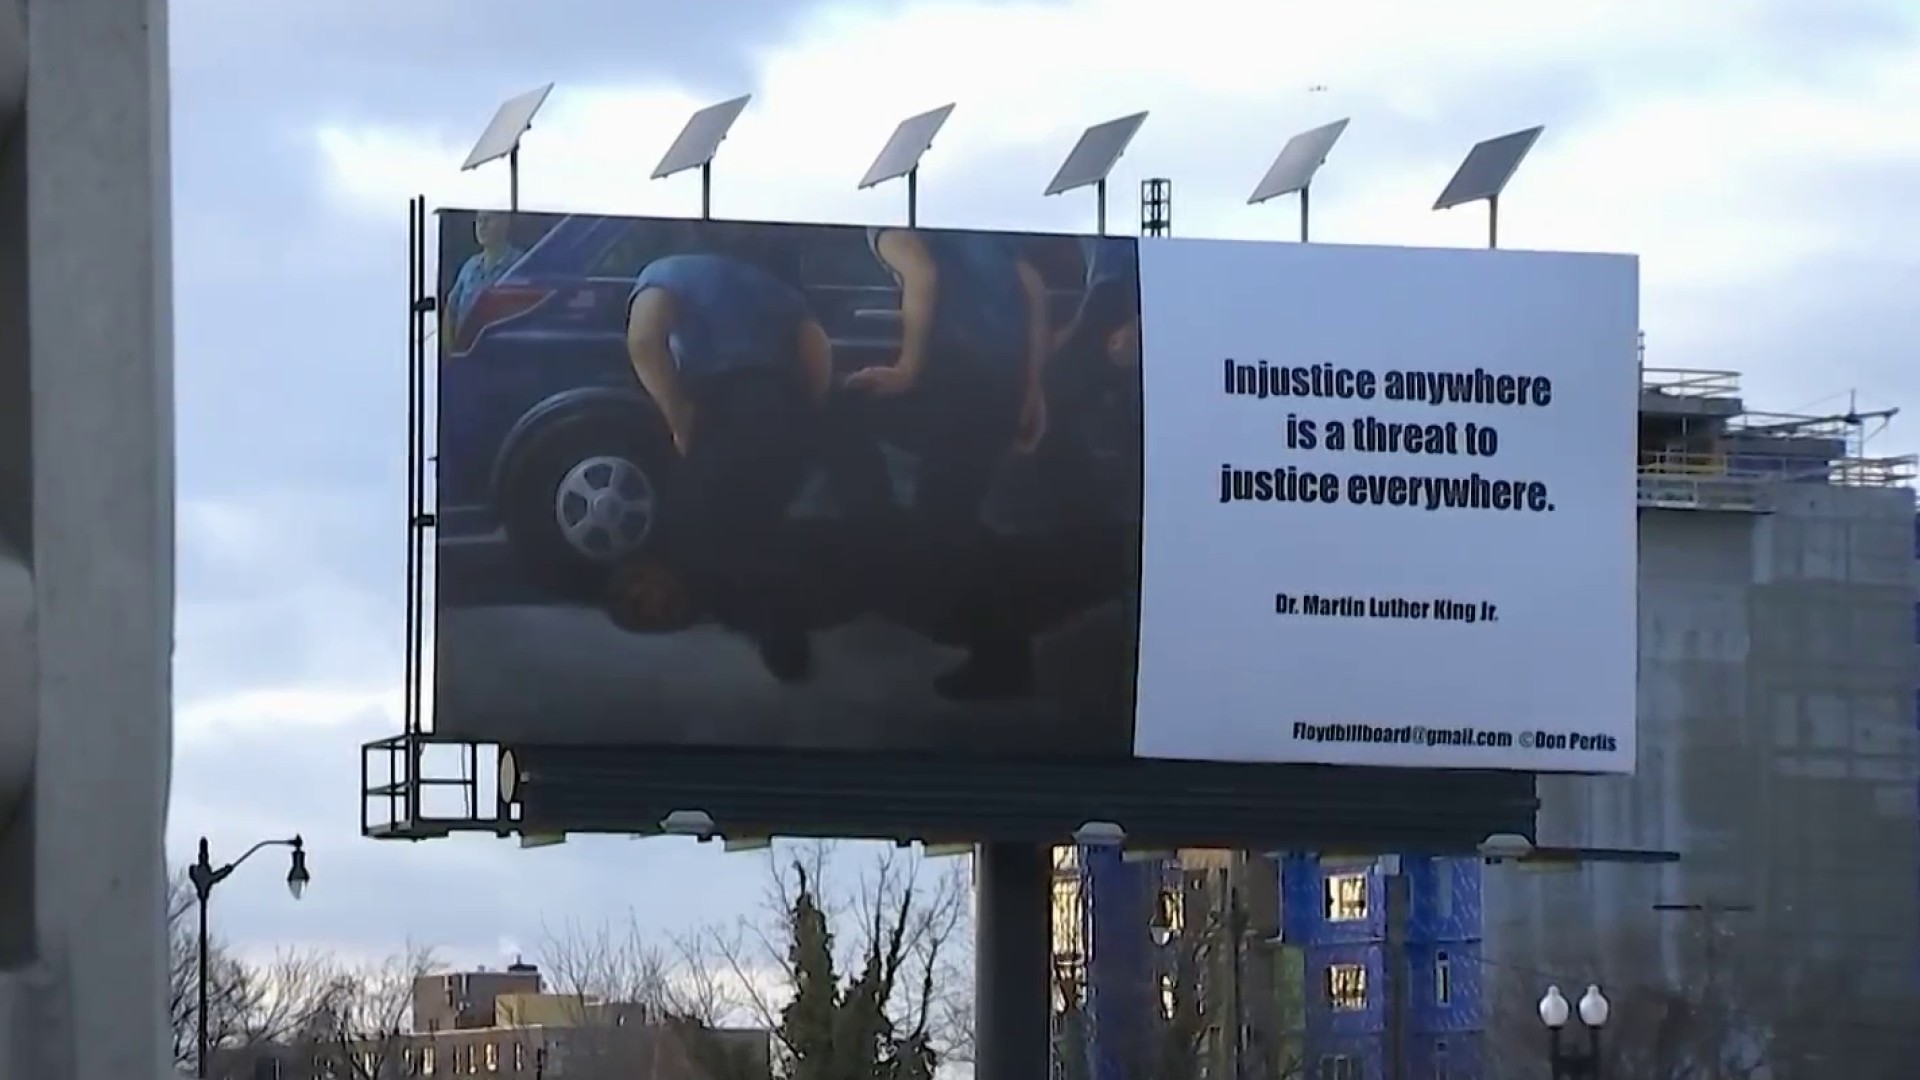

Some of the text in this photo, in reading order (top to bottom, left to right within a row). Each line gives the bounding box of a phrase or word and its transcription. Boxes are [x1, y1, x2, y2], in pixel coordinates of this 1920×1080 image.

[1224, 358, 1552, 407] Injustice anywhere
[1286, 412, 1499, 458] is a threat to
[1219, 463, 1556, 513] justice everywhere.
[1275, 592, 1499, 624] Dr. Martin Luther King Jr.
[1292, 721, 1513, 748] Floydbillboard@gmail.com
